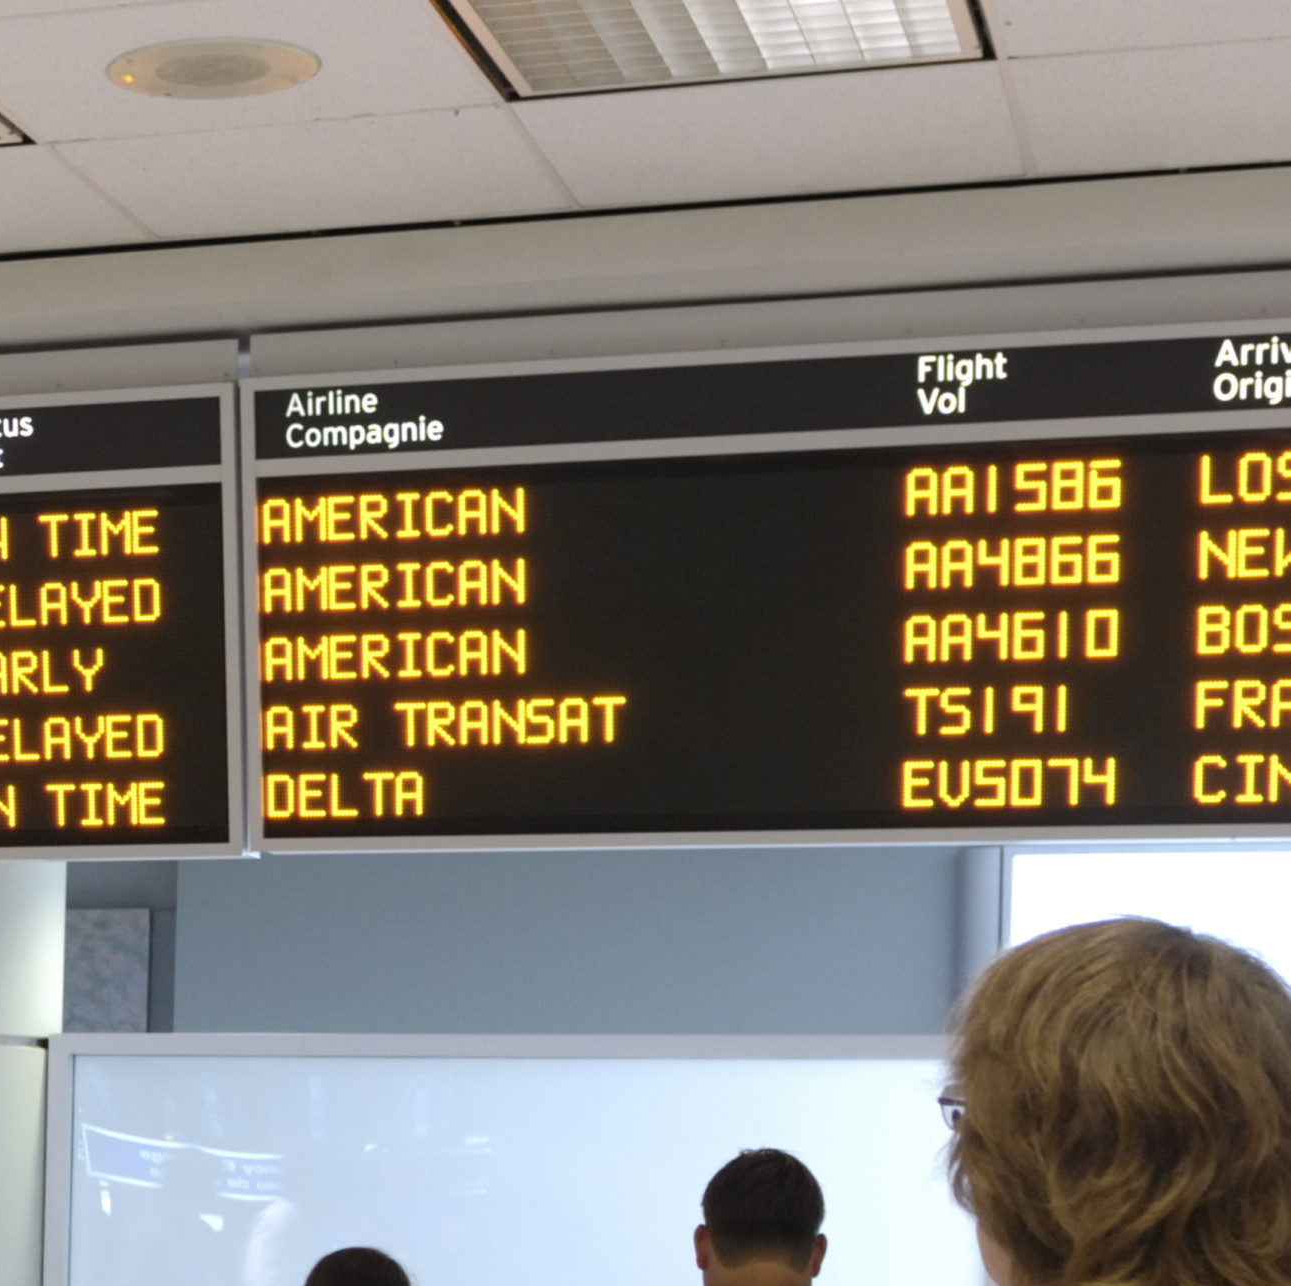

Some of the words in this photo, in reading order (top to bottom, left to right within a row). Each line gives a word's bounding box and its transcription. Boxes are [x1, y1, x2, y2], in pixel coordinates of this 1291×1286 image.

[918, 352, 1007, 386] Flight
[286, 390, 378, 417] Airline
[918, 387, 966, 414] Vol
[286, 415, 443, 450] Compagnie
[906, 459, 1121, 516] AA1586
[38, 510, 159, 558] TIME
[262, 487, 525, 544] AMERICAN
[263, 558, 525, 613] AMERICAN
[905, 534, 1120, 590] AA4866
[262, 629, 526, 682] AMERICAN
[905, 608, 1118, 663] AA4610
[266, 704, 358, 750] AIR
[394, 696, 626, 747] TRANSAT
[904, 685, 1066, 735] TS191
[46, 781, 165, 826] TIME
[267, 771, 423, 818] DELTA
[902, 757, 1115, 808] EV5074
